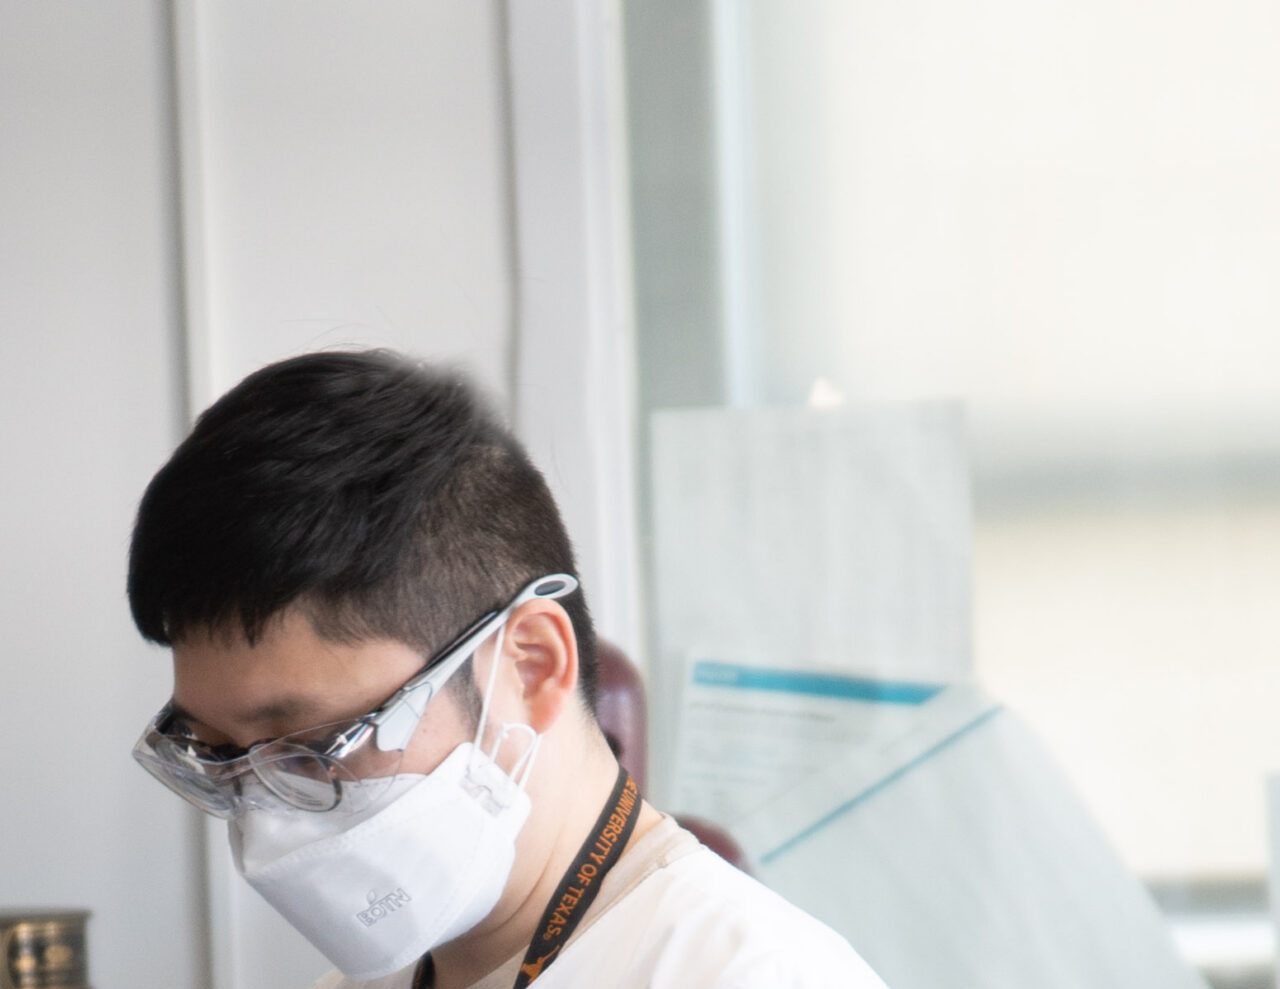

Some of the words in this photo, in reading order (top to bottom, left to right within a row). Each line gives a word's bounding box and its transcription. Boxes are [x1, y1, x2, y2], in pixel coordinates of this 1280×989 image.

[589, 788, 637, 865] UNIVERSITY
[577, 863, 598, 887] OF
[545, 885, 585, 938] TEXAS
